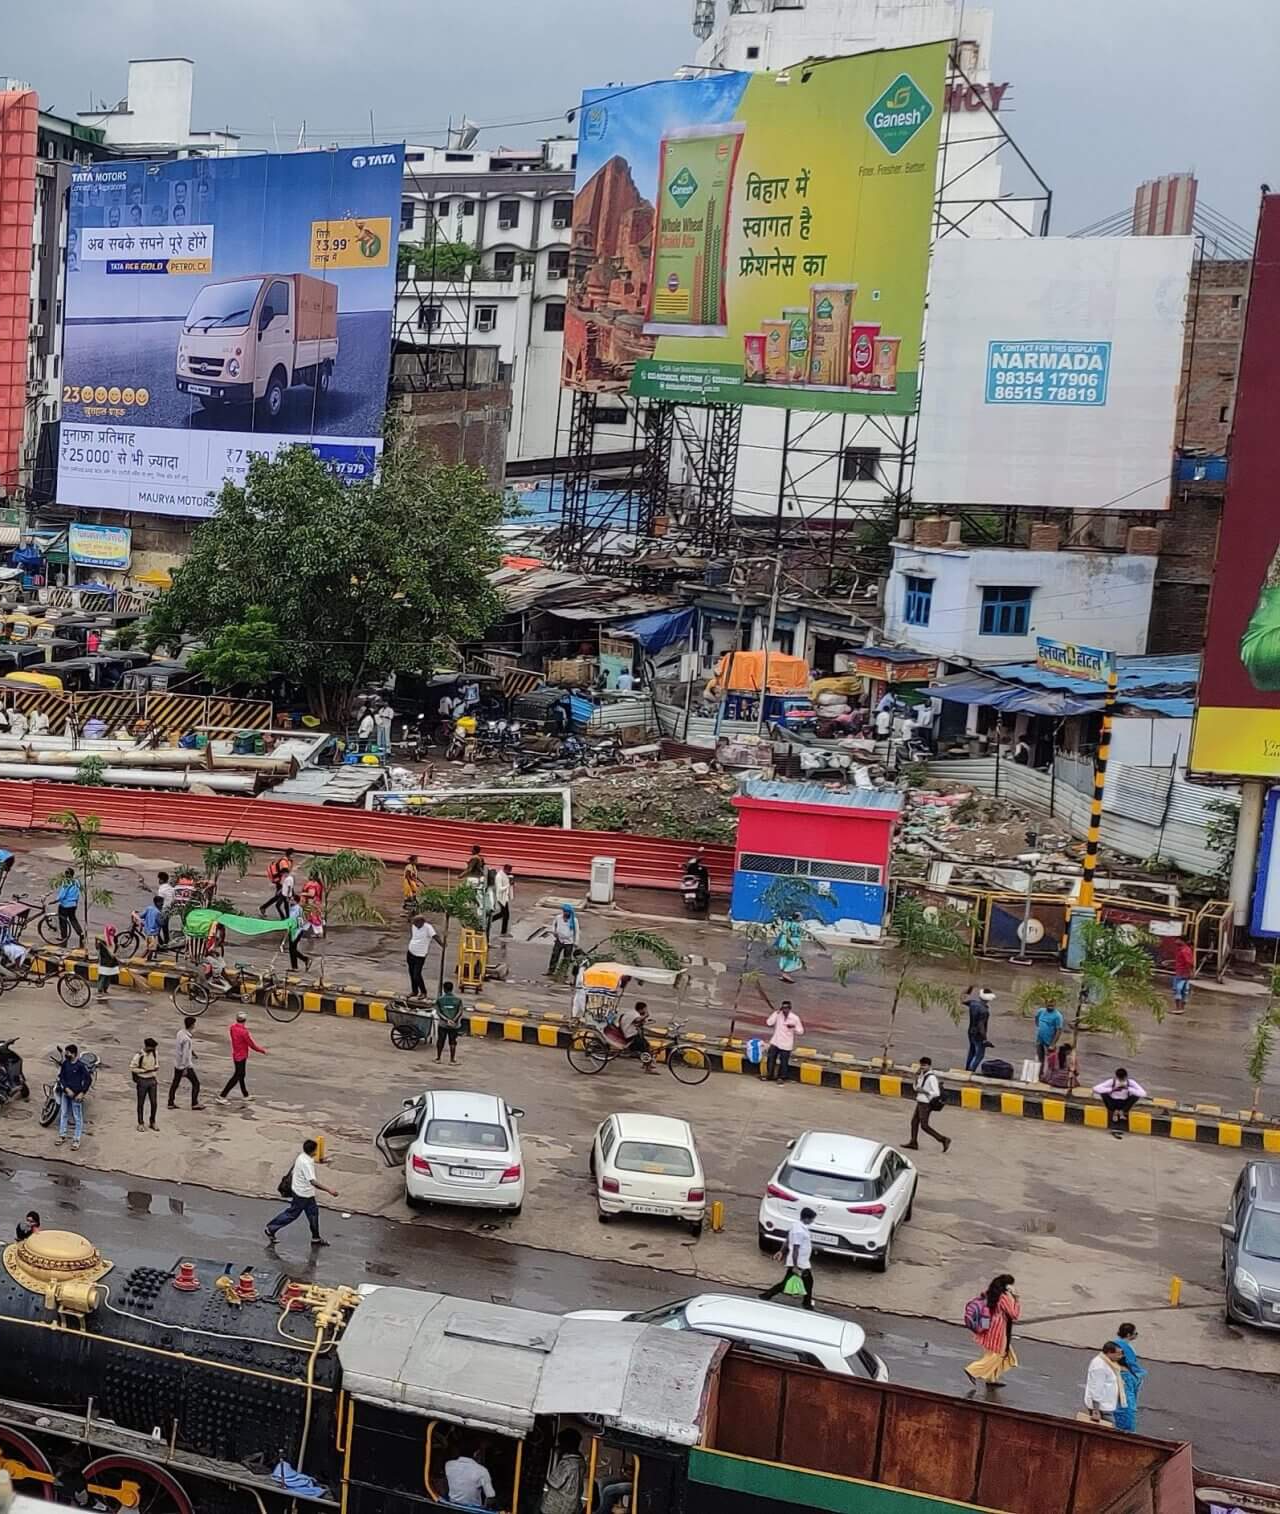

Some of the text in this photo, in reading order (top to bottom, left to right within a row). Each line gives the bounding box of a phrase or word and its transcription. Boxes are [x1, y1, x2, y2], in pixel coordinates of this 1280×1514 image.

[873, 109, 921, 129] Ganesh
[367, 153, 397, 166] TATA
[72, 171, 127, 183] TATA MOTORS
[746, 169, 811, 204] बिहार में
[743, 206, 812, 240] स्वागत है
[88, 231, 208, 255] अब सबके सपने पूरे होंगे
[111, 263, 124, 271] TATA
[140, 262, 163, 271] GOLD
[170, 262, 197, 271] PETROL
[197, 262, 208, 271] CX
[739, 247, 827, 278] फ्रेशनेस का
[1001, 345, 1098, 353] CONTACT FOR THIS DISPLAY
[992, 352, 1104, 371] NARMADA
[995, 371, 1098, 387] 98354 17906
[995, 386, 1097, 401] 86515 78819
[98, 427, 136, 448] प्रतिमाह
[117, 448, 127, 465] से
[130, 448, 144, 467] भी
[138, 492, 216, 508] MAURYA MOTORS
